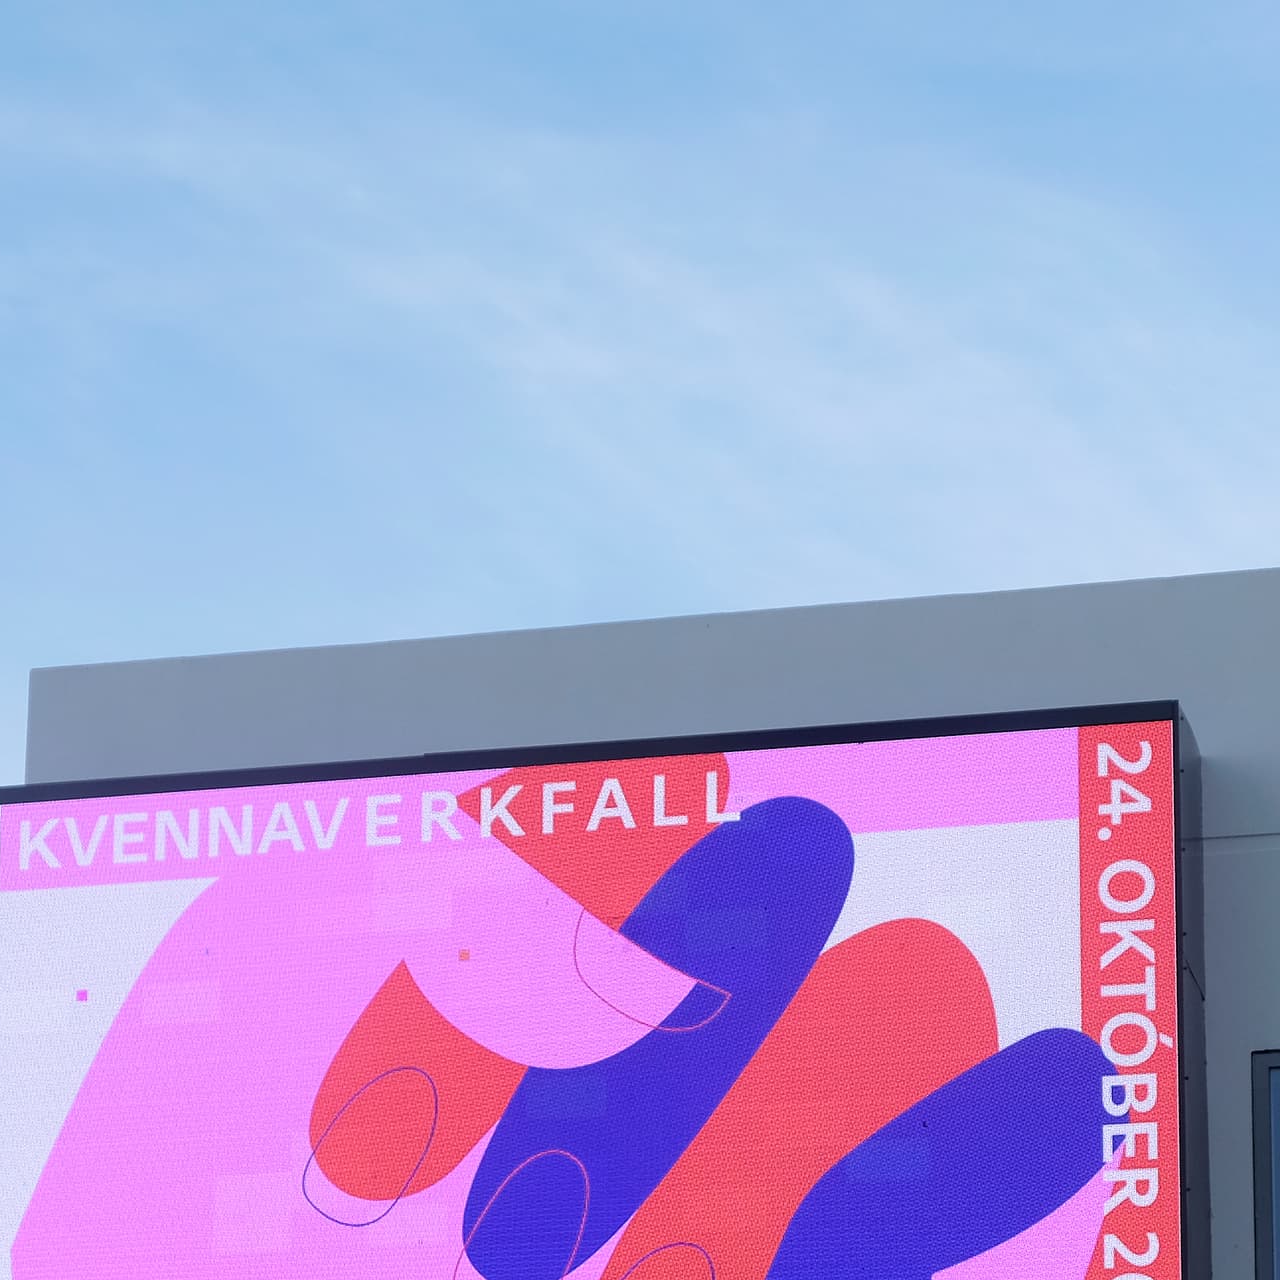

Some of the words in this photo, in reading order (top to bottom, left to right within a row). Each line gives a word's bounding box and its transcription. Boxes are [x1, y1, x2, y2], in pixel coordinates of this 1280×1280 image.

[18, 770, 742, 871] KVENNAVERKFALL
[1096, 739, 1153, 842] 24.
[1097, 858, 1174, 1217] OKTÓBER
